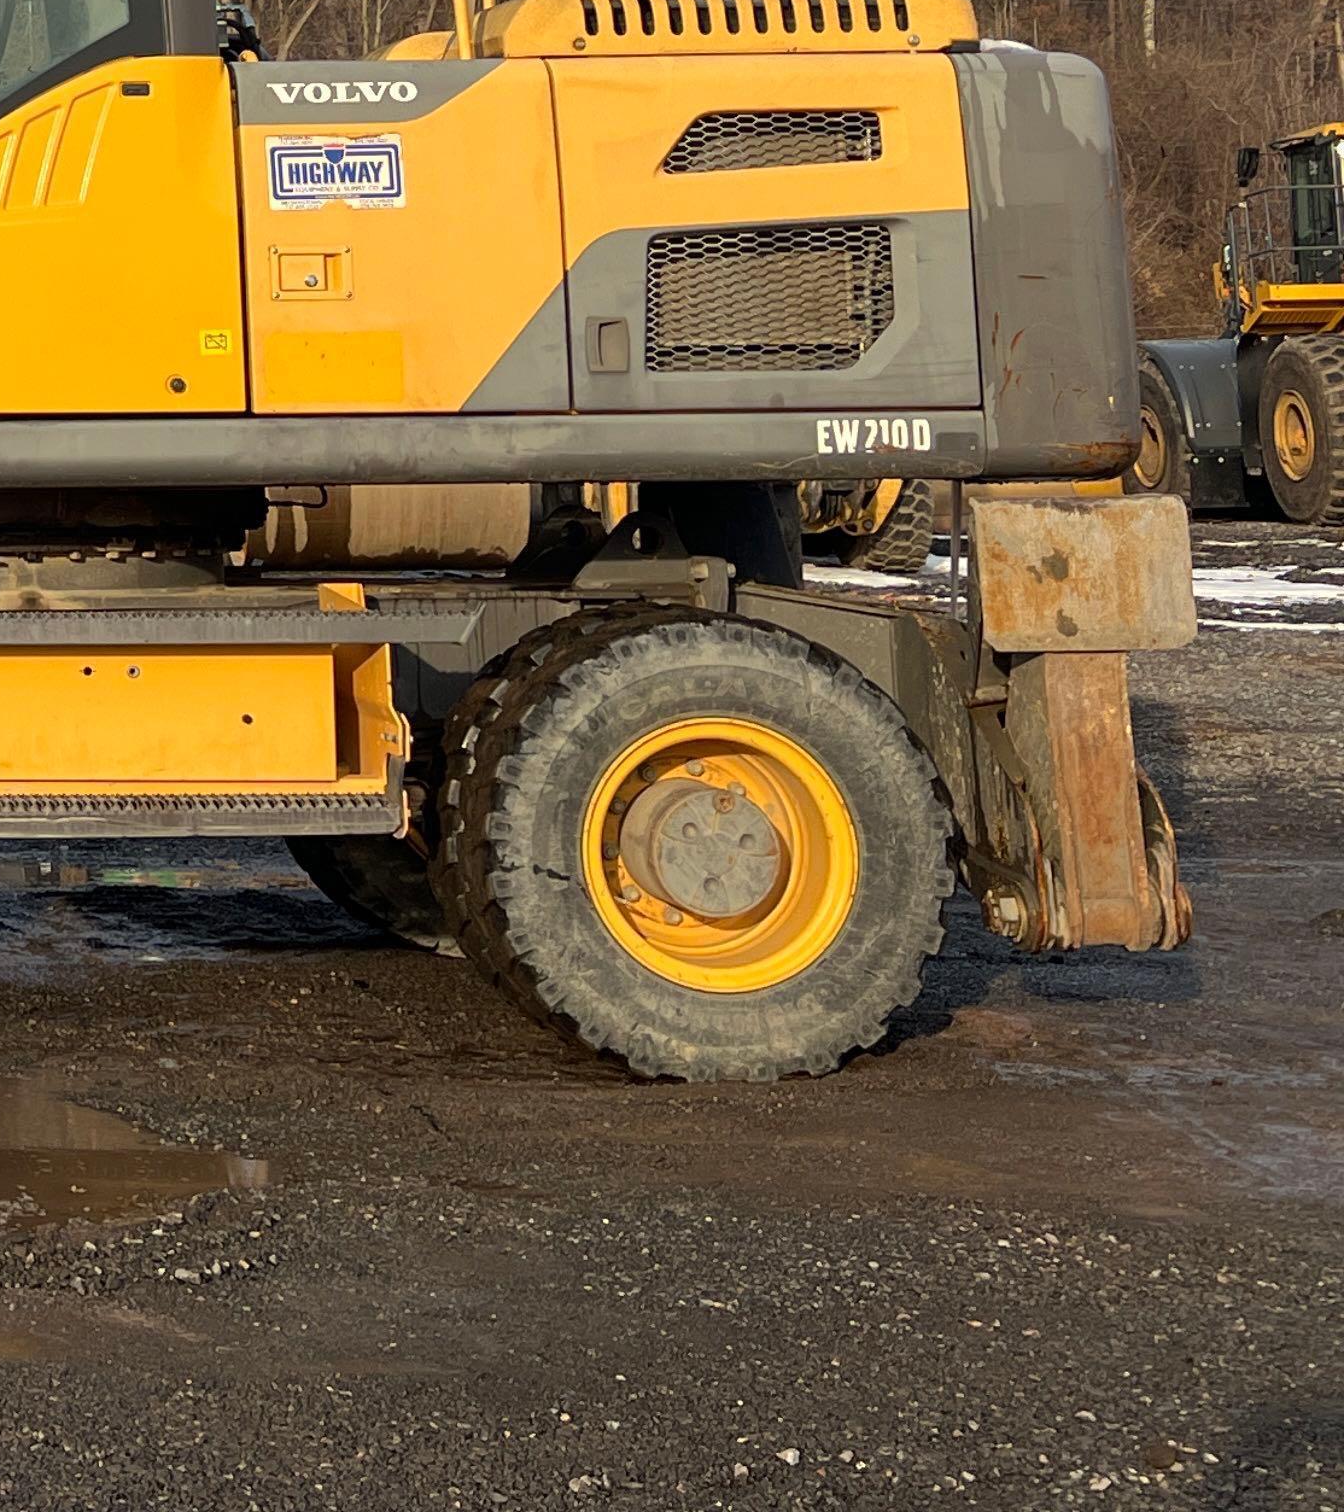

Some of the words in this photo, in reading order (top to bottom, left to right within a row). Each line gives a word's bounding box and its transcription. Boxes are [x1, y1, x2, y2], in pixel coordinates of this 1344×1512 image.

[266, 81, 418, 104] VOLVO
[287, 161, 384, 185] HIGHWAY
[816, 418, 931, 454] EW210D
